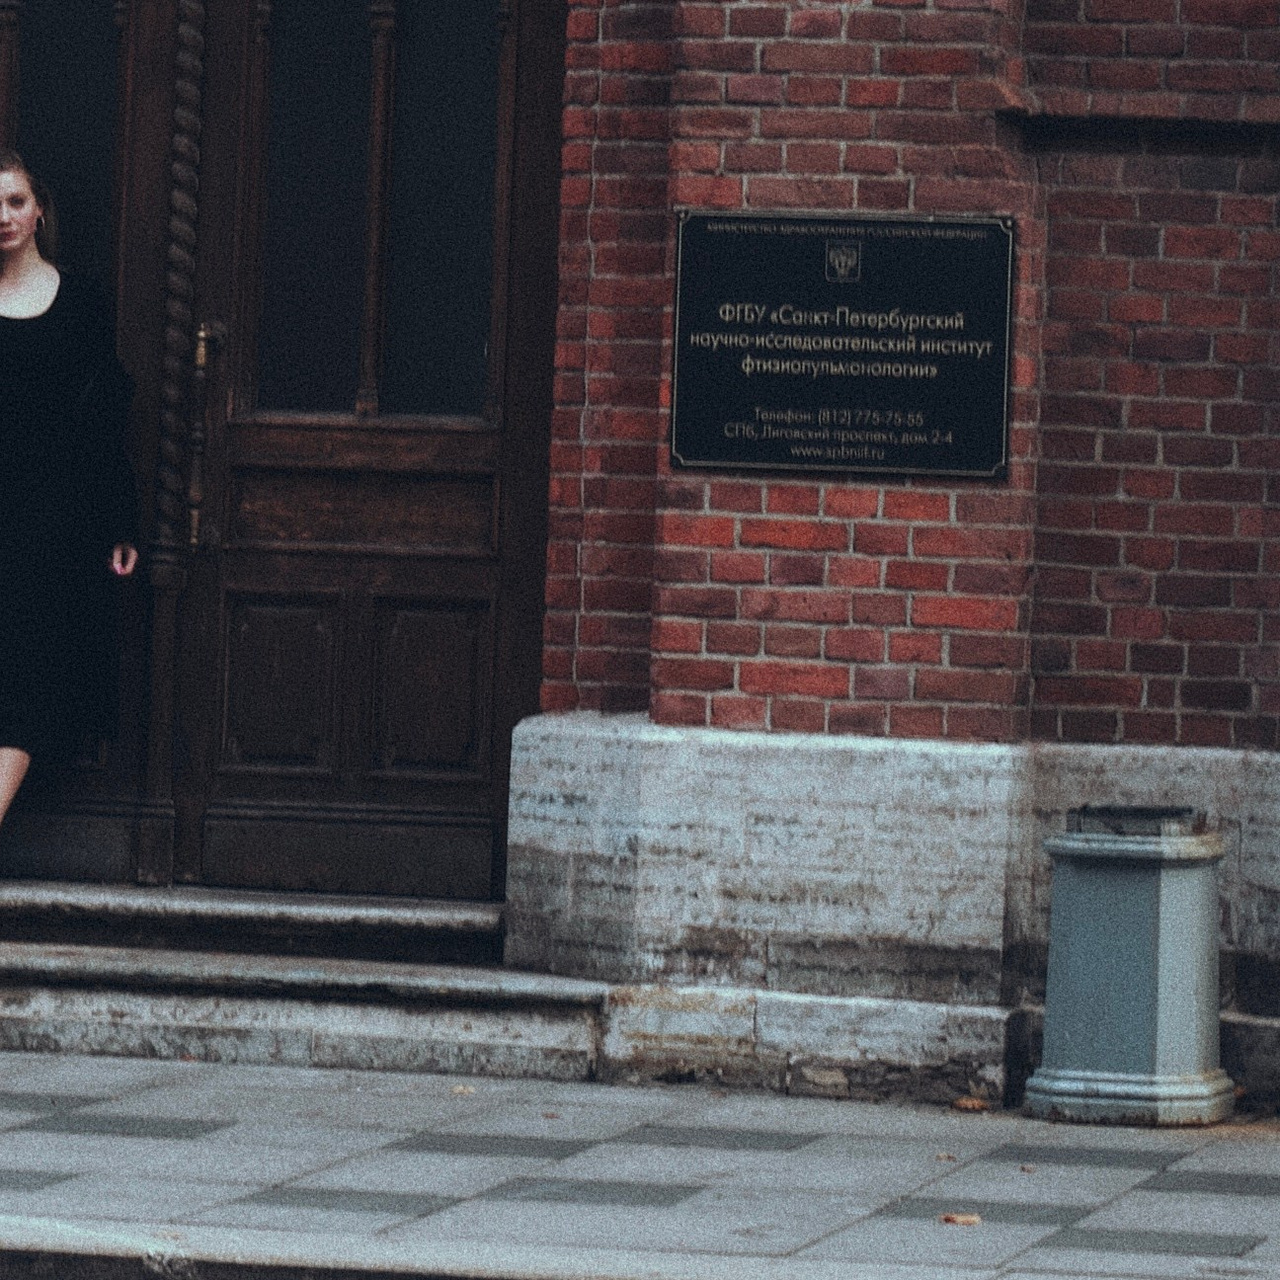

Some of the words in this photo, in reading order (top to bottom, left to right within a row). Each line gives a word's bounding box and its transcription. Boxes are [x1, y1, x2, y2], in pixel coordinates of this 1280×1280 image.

[719, 303, 767, 323] ФГБУ
[770, 304, 965, 333] «Санкт-Петербургский
[690, 331, 917, 354] научно-исследовательский
[921, 339, 993, 359] институт
